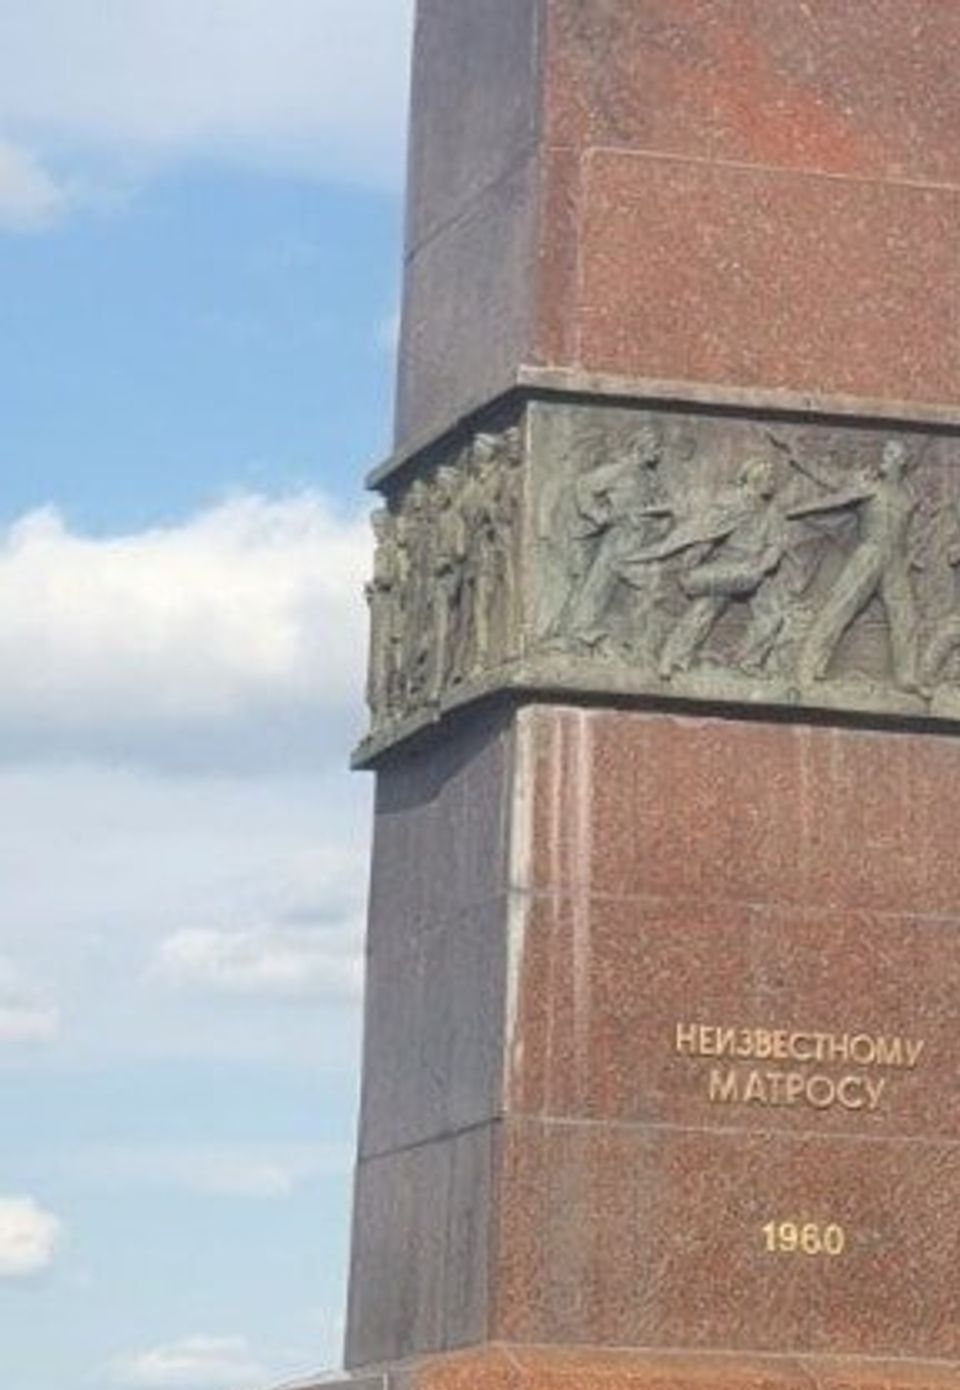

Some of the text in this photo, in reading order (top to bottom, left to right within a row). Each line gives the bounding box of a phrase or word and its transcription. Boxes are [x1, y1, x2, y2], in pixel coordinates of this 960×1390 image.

[676, 1023, 924, 1066] НЕИЗВЕСТНОМУ
[709, 1069, 885, 1109] МАТРОСУ
[762, 1221, 846, 1254] 1960
